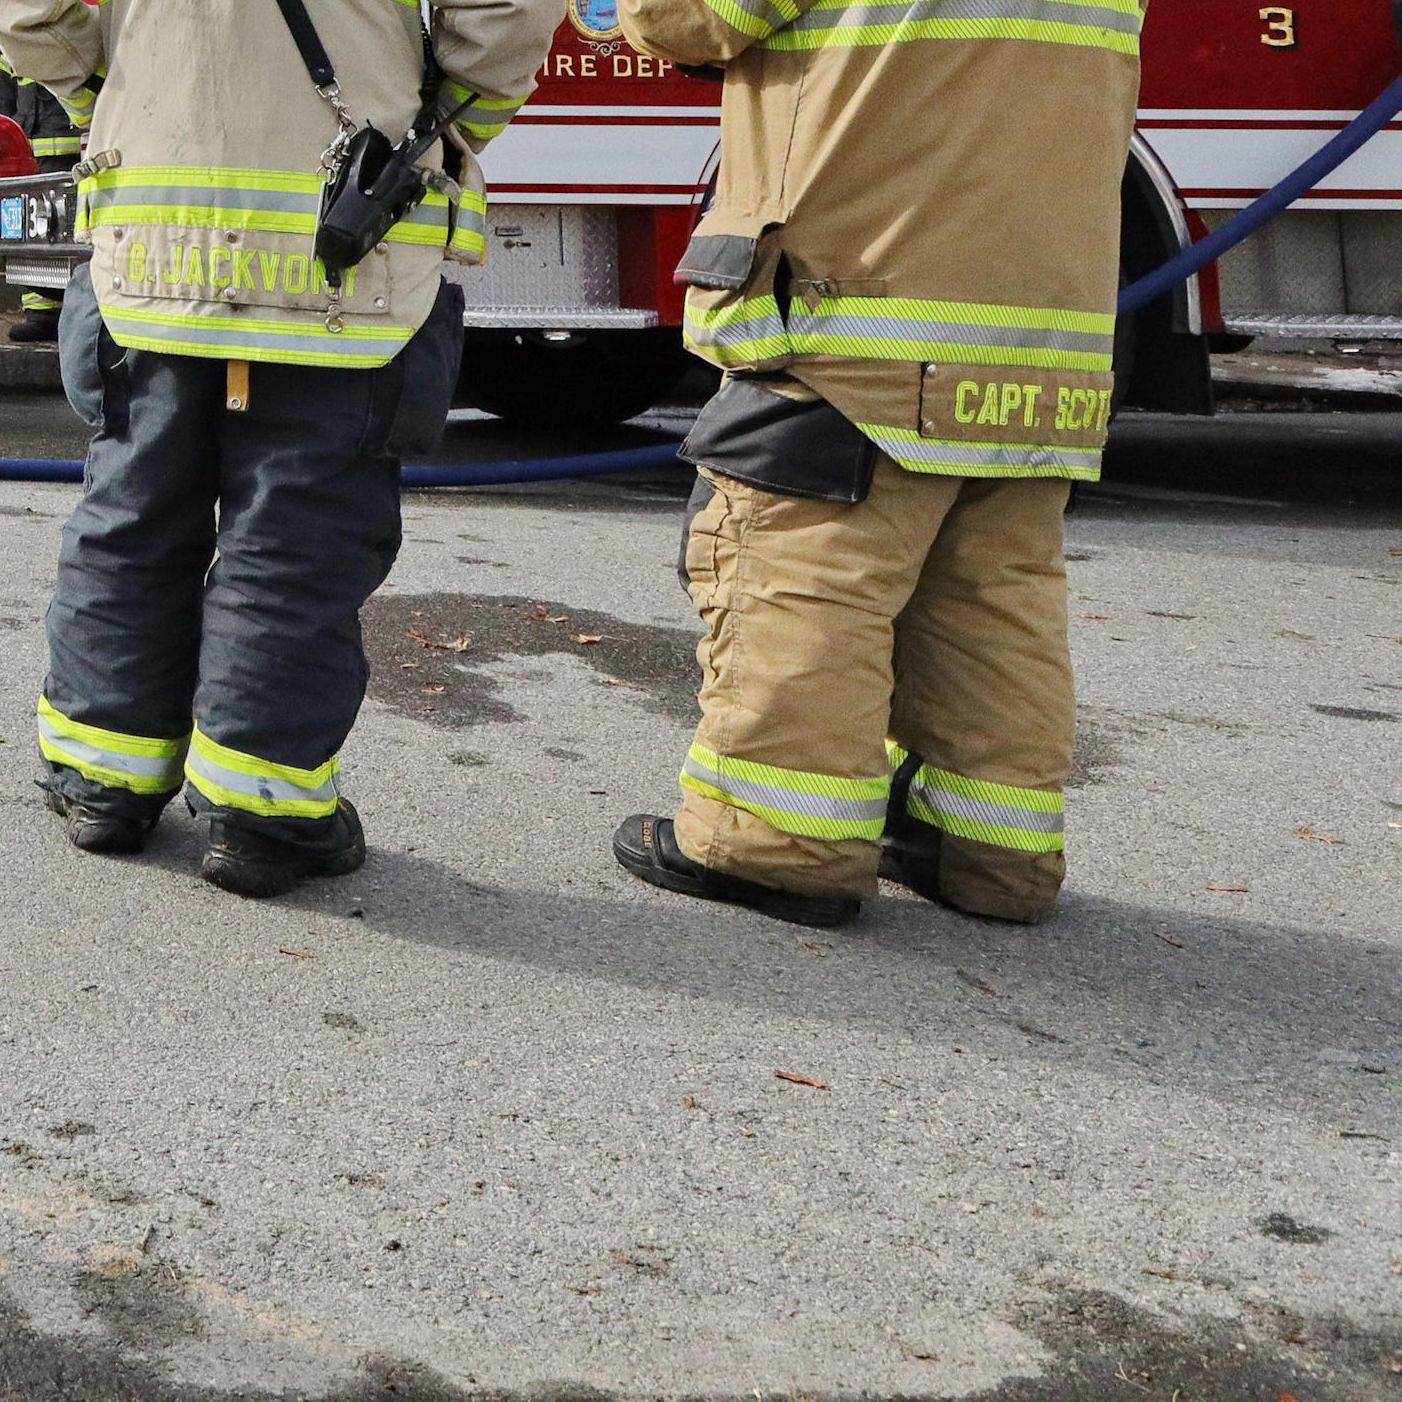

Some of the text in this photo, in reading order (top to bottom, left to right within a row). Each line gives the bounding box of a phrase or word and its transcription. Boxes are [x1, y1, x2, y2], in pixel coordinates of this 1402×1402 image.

[1258, 6, 1295, 47] 3
[128, 242, 156, 283] B.
[954, 380, 1042, 427] CAPT.
